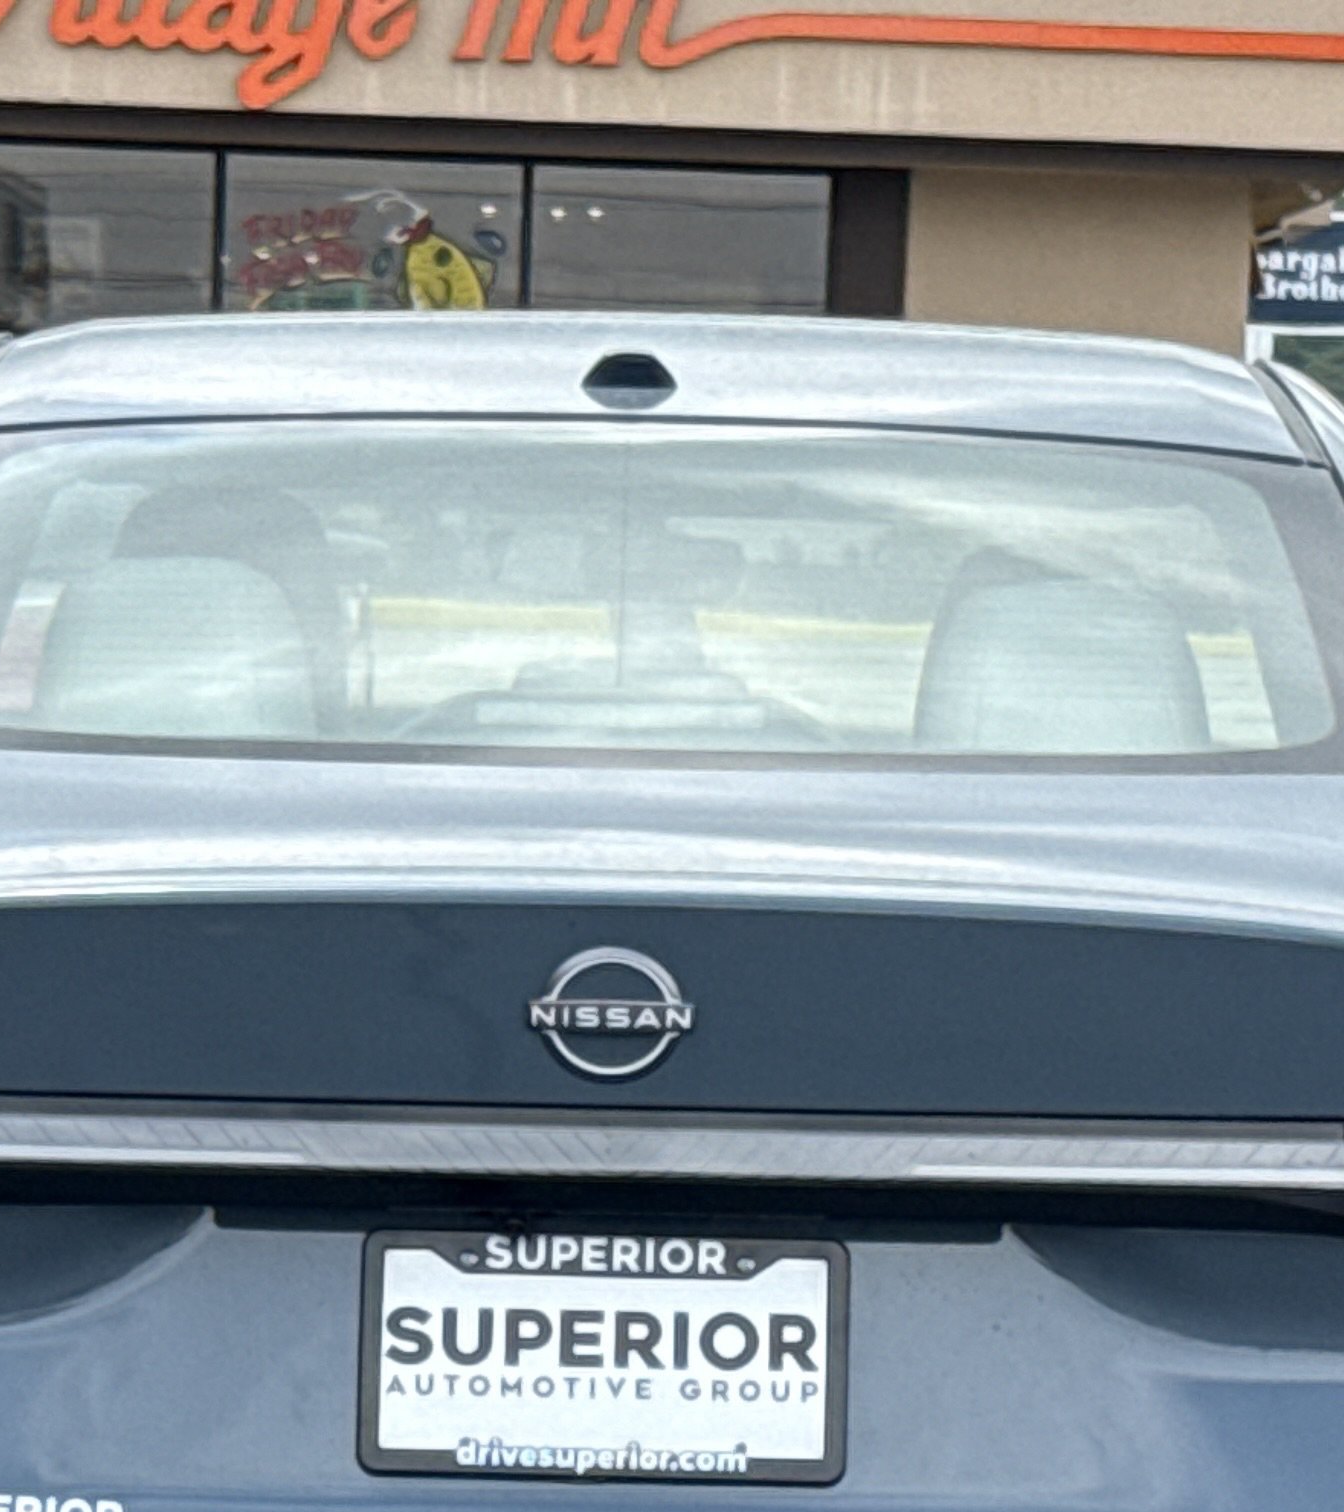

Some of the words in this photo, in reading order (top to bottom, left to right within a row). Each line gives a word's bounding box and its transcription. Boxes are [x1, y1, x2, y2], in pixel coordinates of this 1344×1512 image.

[530, 1004, 693, 1029] NISSAN
[484, 1234, 727, 1275] SUPERIOR
[385, 1306, 819, 1372] SUPERIOR
[385, 1374, 652, 1400] AUTOMOTIVE
[679, 1379, 820, 1402] GROUP
[456, 1437, 748, 1475] drivesuperior.com
